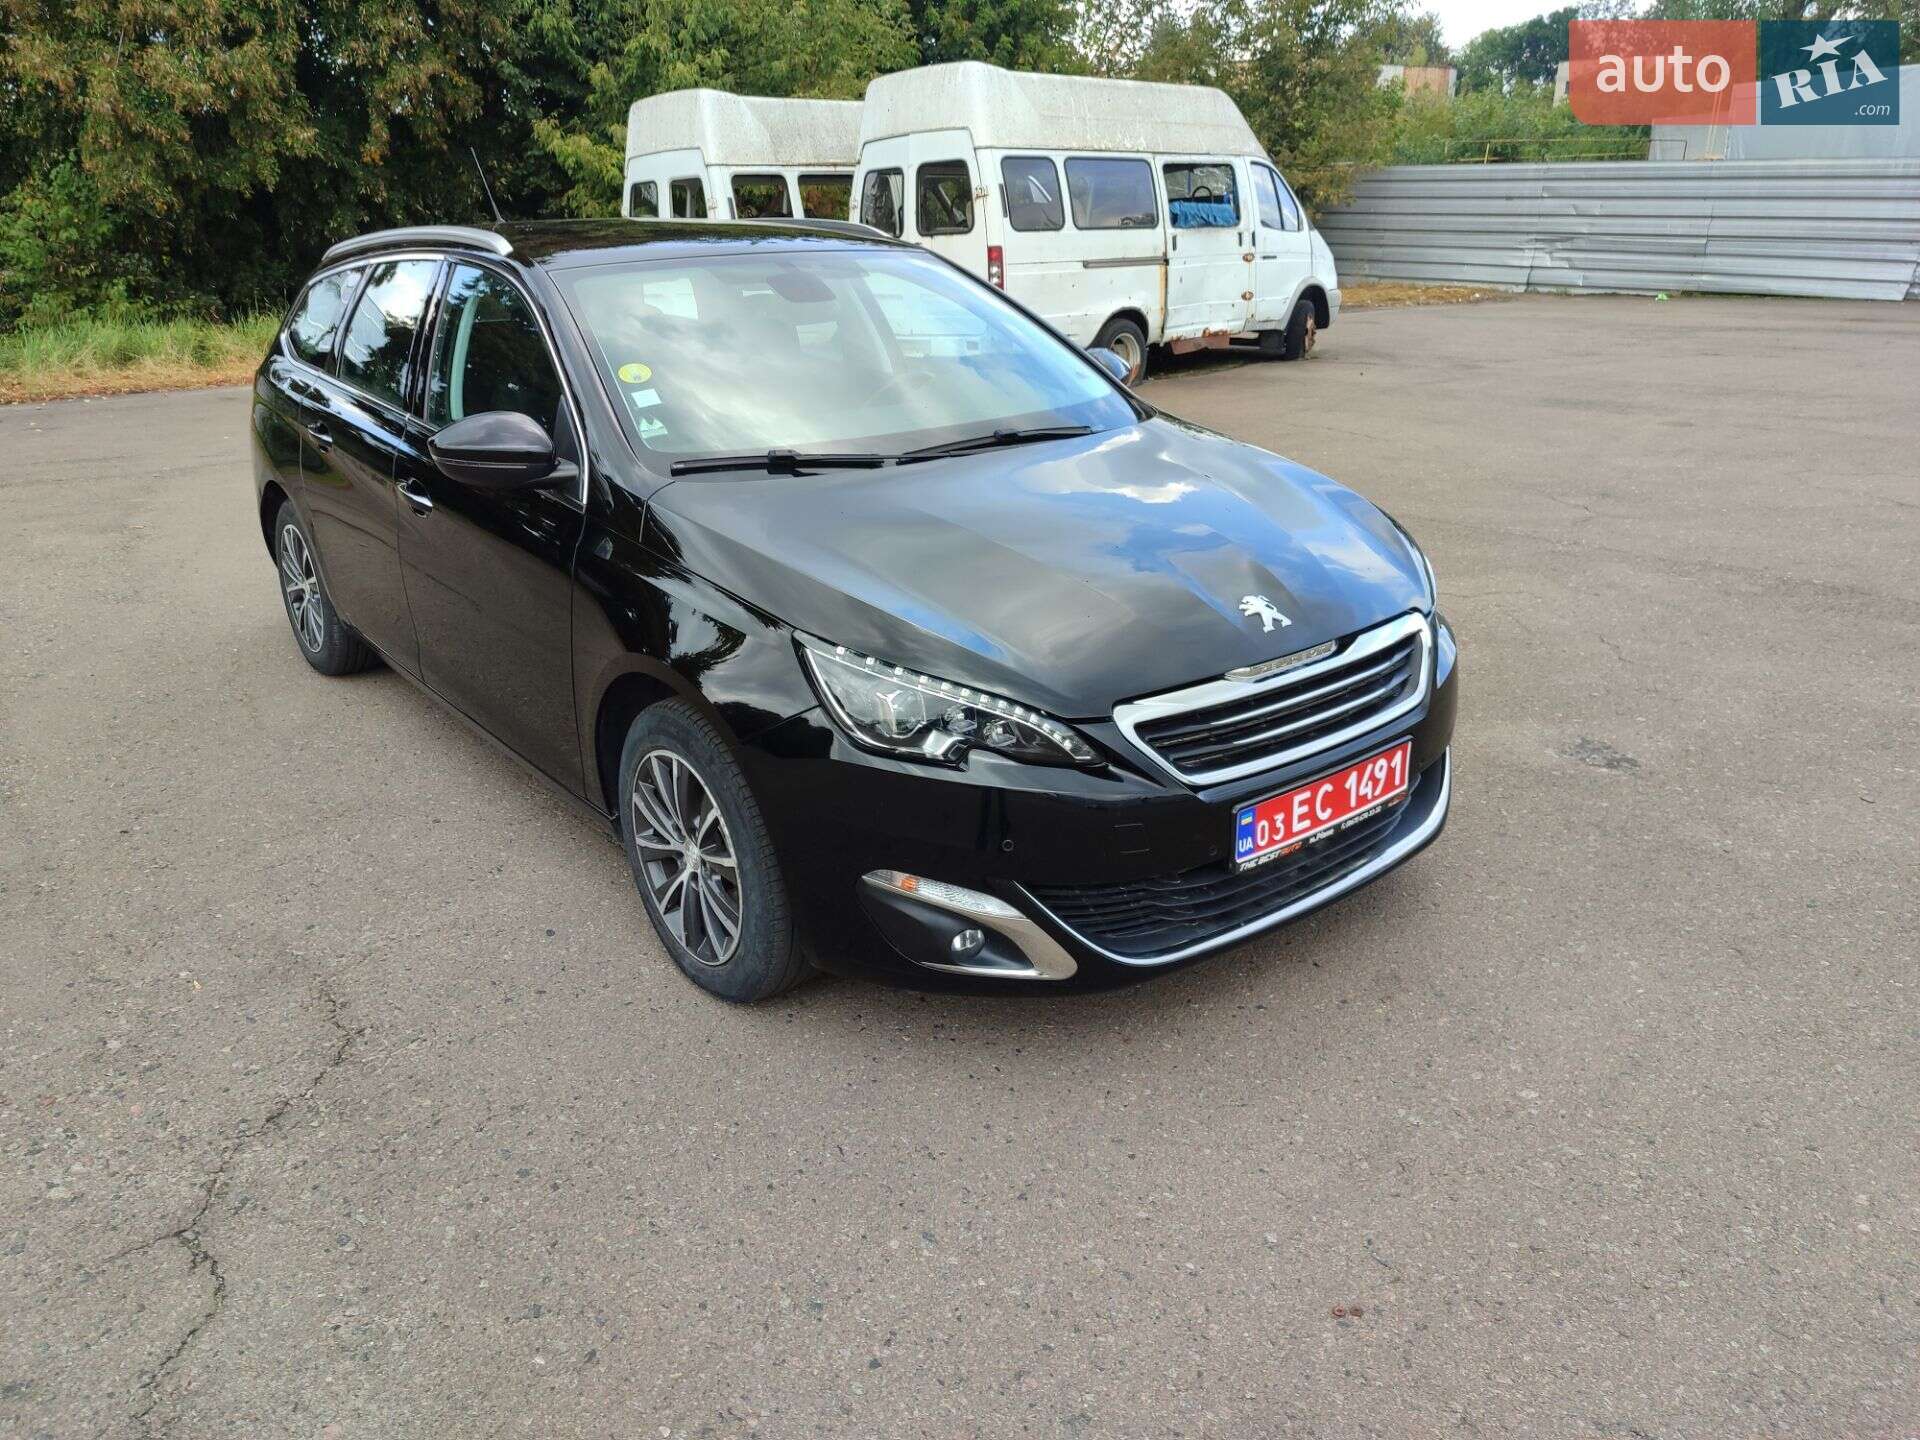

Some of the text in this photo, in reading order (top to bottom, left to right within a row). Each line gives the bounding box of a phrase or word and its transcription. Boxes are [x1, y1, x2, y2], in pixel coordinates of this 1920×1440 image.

[1257, 811, 1285, 847] 03
[1292, 783, 1333, 833] EC
[1344, 750, 1402, 808] 1491
[1238, 836, 1253, 852] UA
